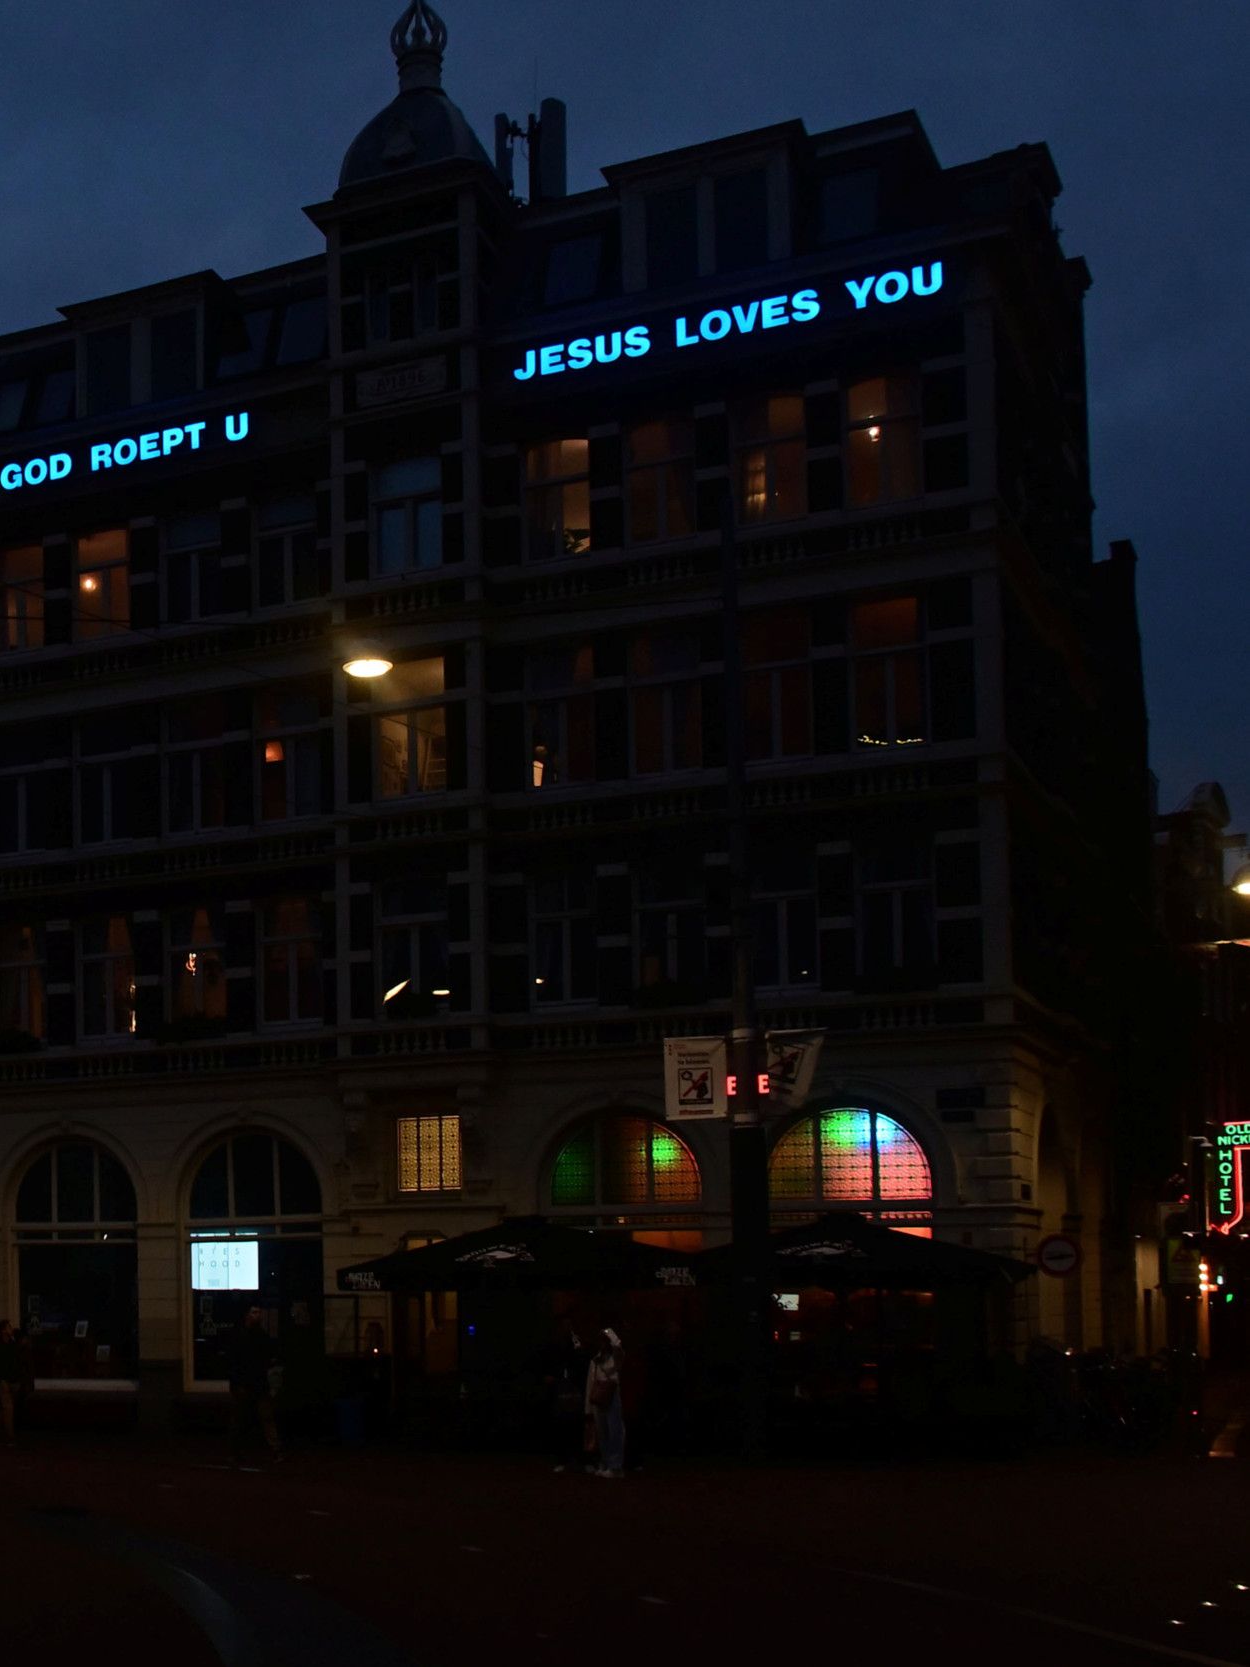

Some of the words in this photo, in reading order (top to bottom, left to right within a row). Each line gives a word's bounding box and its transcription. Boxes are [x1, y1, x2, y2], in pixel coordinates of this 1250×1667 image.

[513, 325, 651, 381] JESUS
[675, 289, 821, 348] LOVES
[844, 261, 943, 310] YOU
[0, 452, 73, 490] GOD
[90, 421, 206, 472] ROEPT
[225, 412, 249, 442] U
[1217, 1134, 1250, 1146] NICK
[1225, 1123, 1250, 1135] OLD
[1218, 1149, 1233, 1215] HOTEL
